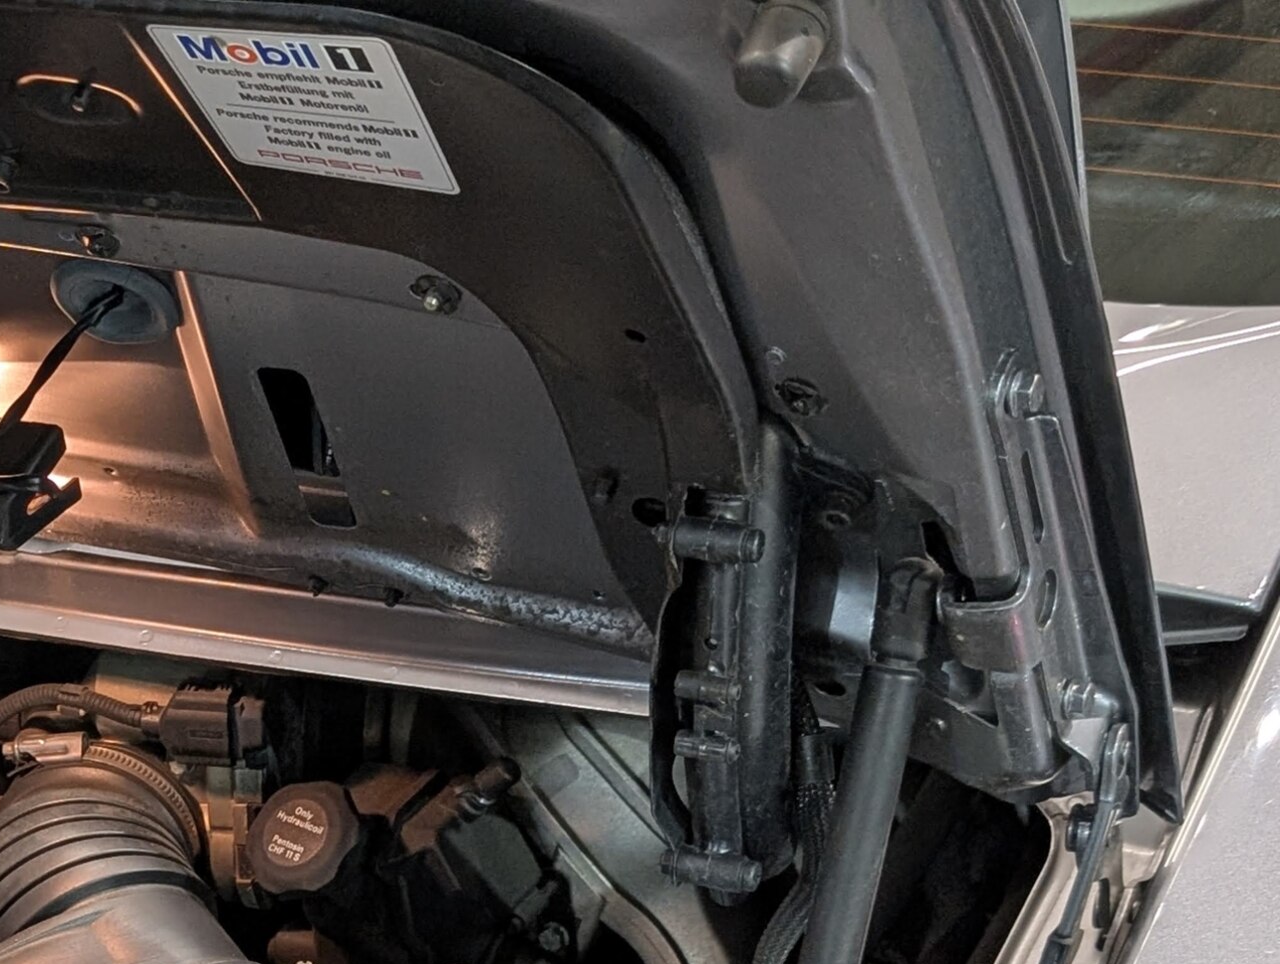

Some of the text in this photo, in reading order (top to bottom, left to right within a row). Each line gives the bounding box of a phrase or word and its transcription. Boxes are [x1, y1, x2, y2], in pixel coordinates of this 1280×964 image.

[175, 34, 321, 68] Mobil
[195, 65, 253, 77] Porsche
[254, 70, 323, 85] empfiehlt
[236, 80, 355, 99] Erstbefüllung mit
[298, 98, 370, 113] Motorenöl
[214, 108, 270, 121] Porsche
[271, 114, 361, 132] recommends
[262, 125, 382, 146] Factory filled with
[325, 144, 373, 157] engine
[373, 149, 392, 158] oil
[256, 149, 424, 180] PORSCHE
[277, 810, 324, 834] Hydraulicoil
[295, 806, 314, 820] Only
[268, 844, 285, 854] CHF
[272, 834, 304, 853] Pentosin
